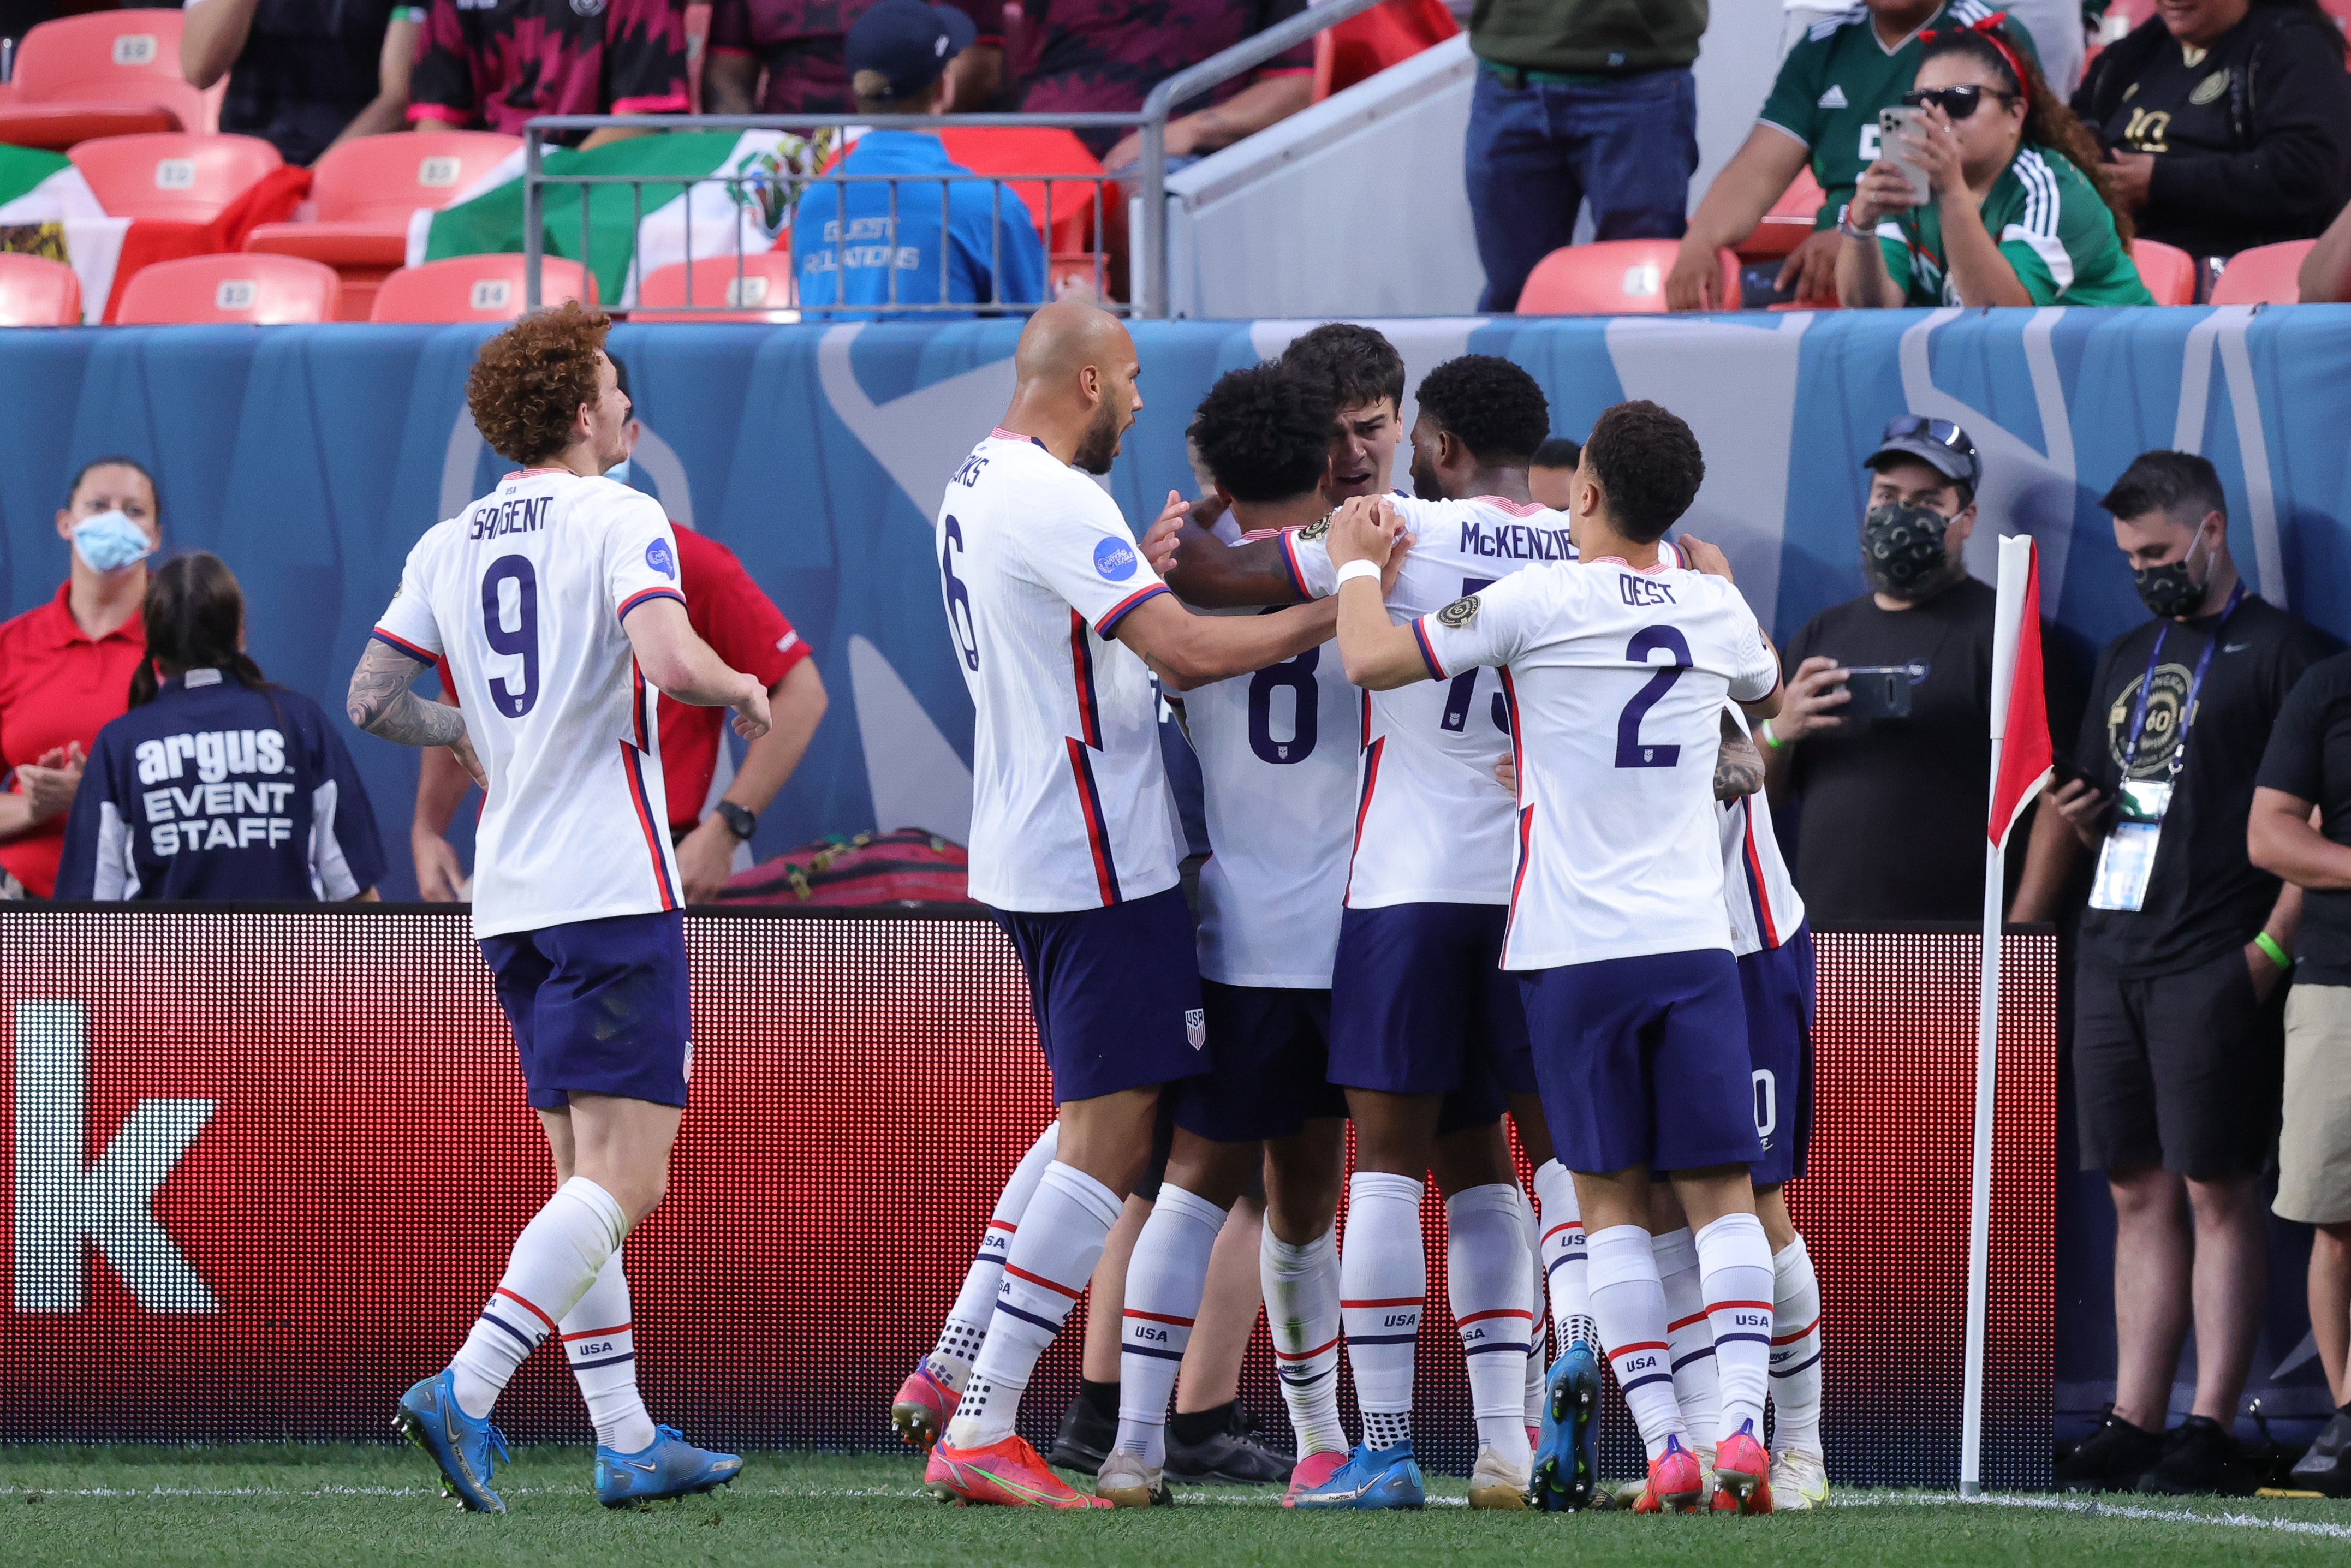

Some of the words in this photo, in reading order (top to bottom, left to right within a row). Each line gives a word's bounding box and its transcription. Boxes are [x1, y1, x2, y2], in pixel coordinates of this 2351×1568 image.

[2124, 107, 2172, 153] 10
[505, 486, 517, 496] USA
[1460, 521, 1579, 561] McKENZIE
[943, 514, 979, 672] 6
[1619, 573, 1677, 606] DEST
[481, 553, 539, 719] 9
[1614, 624, 1694, 768] 2
[2145, 709, 2171, 732] 60
[135, 728, 286, 785] argus
[142, 781, 295, 824] EVENT
[150, 817, 294, 857] STAFF
[1186, 1010, 1203, 1027] USA
[14, 999, 215, 1313] k
[982, 1235, 1005, 1249] SA
[1561, 1234, 1587, 1247] US
[1135, 1326, 1168, 1342] USA
[1384, 1314, 1416, 1327] USA
[1735, 1314, 1769, 1328] USA
[580, 1342, 614, 1356] USA
[1626, 1356, 1657, 1373] USA
